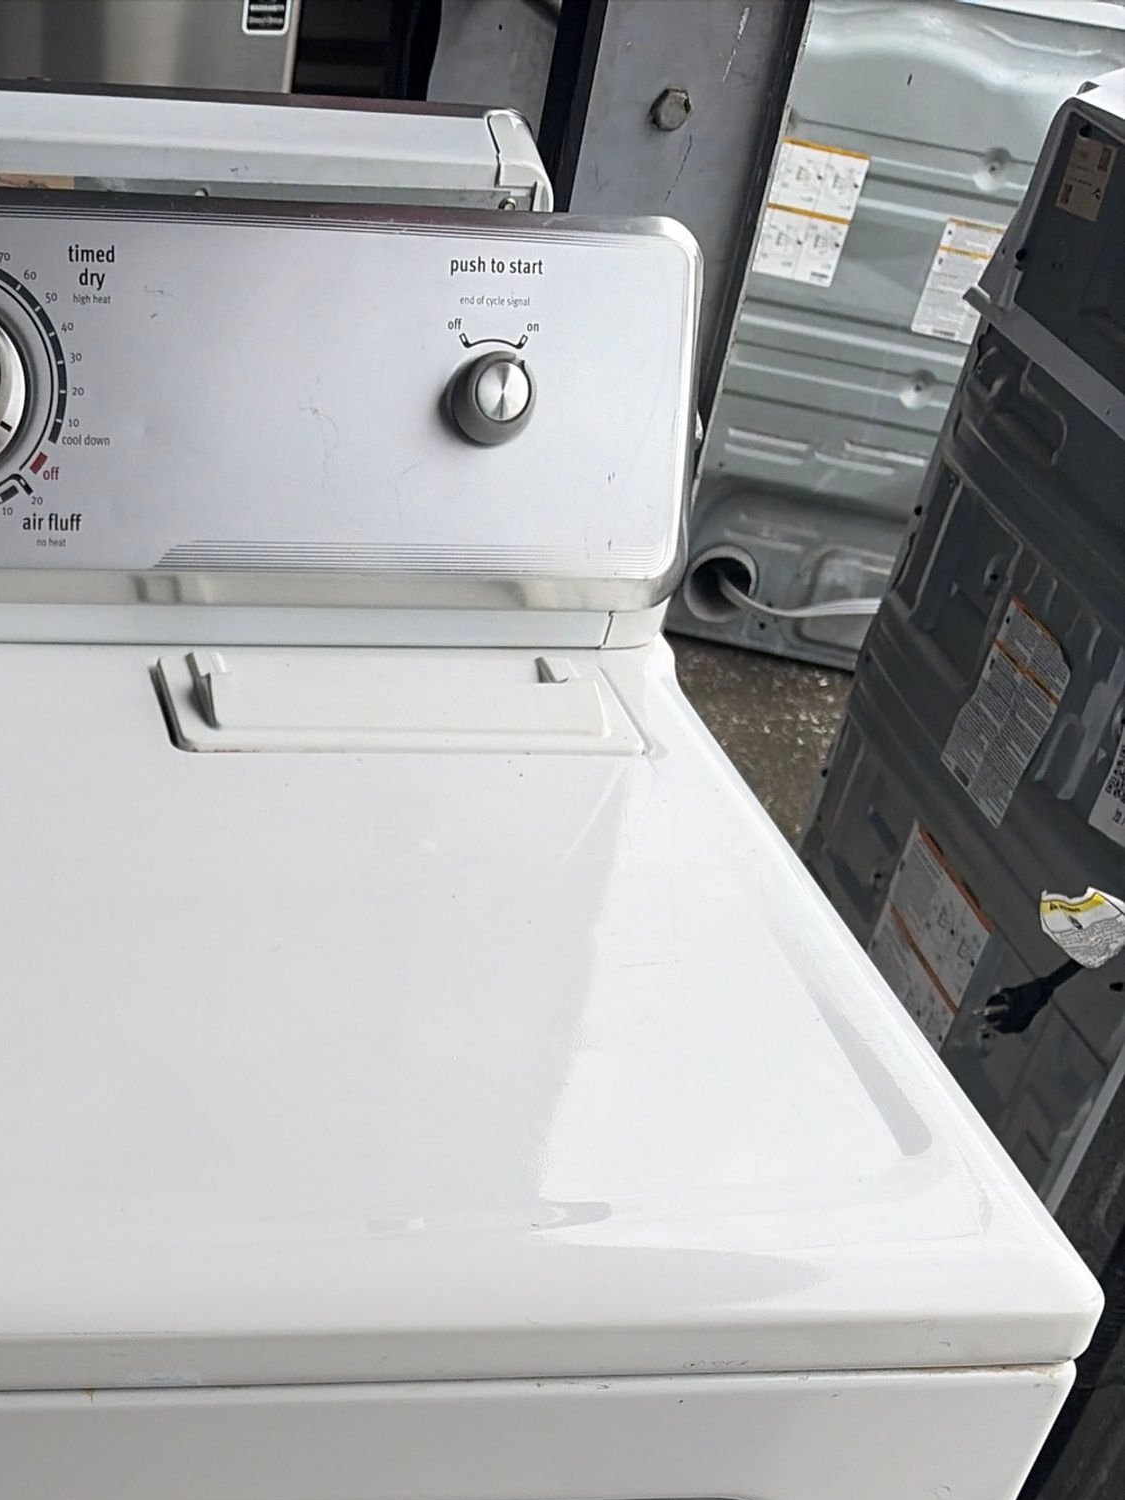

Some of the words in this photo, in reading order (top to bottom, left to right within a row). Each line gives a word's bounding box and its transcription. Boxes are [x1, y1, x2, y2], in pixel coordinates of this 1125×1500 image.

[67, 243, 115, 263] timed
[450, 255, 487, 276] push
[490, 257, 506, 273] to
[508, 258, 544, 275] start
[23, 268, 37, 281] 60
[78, 267, 106, 291] dry
[45, 292, 58, 304] 50
[72, 293, 91, 306] high
[92, 294, 112, 305] heat
[459, 296, 475, 305] end
[476, 295, 485, 305] of
[485, 296, 506, 308] cycle
[506, 296, 531, 308] signal
[61, 322, 75, 333] 40
[447, 317, 463, 330] off
[526, 322, 540, 332] on
[69, 352, 83, 364] 30
[71, 387, 85, 397] 20
[68, 418, 80, 428] 10
[61, 434, 82, 446] cool
[83, 433, 111, 446] down
[42, 466, 60, 481] off
[30, 495, 44, 506] 20
[2, 506, 14, 516] 10
[22, 512, 44, 531] air
[47, 512, 83, 532] fluff
[36, 538, 47, 548] no
[48, 536, 67, 548] heat
